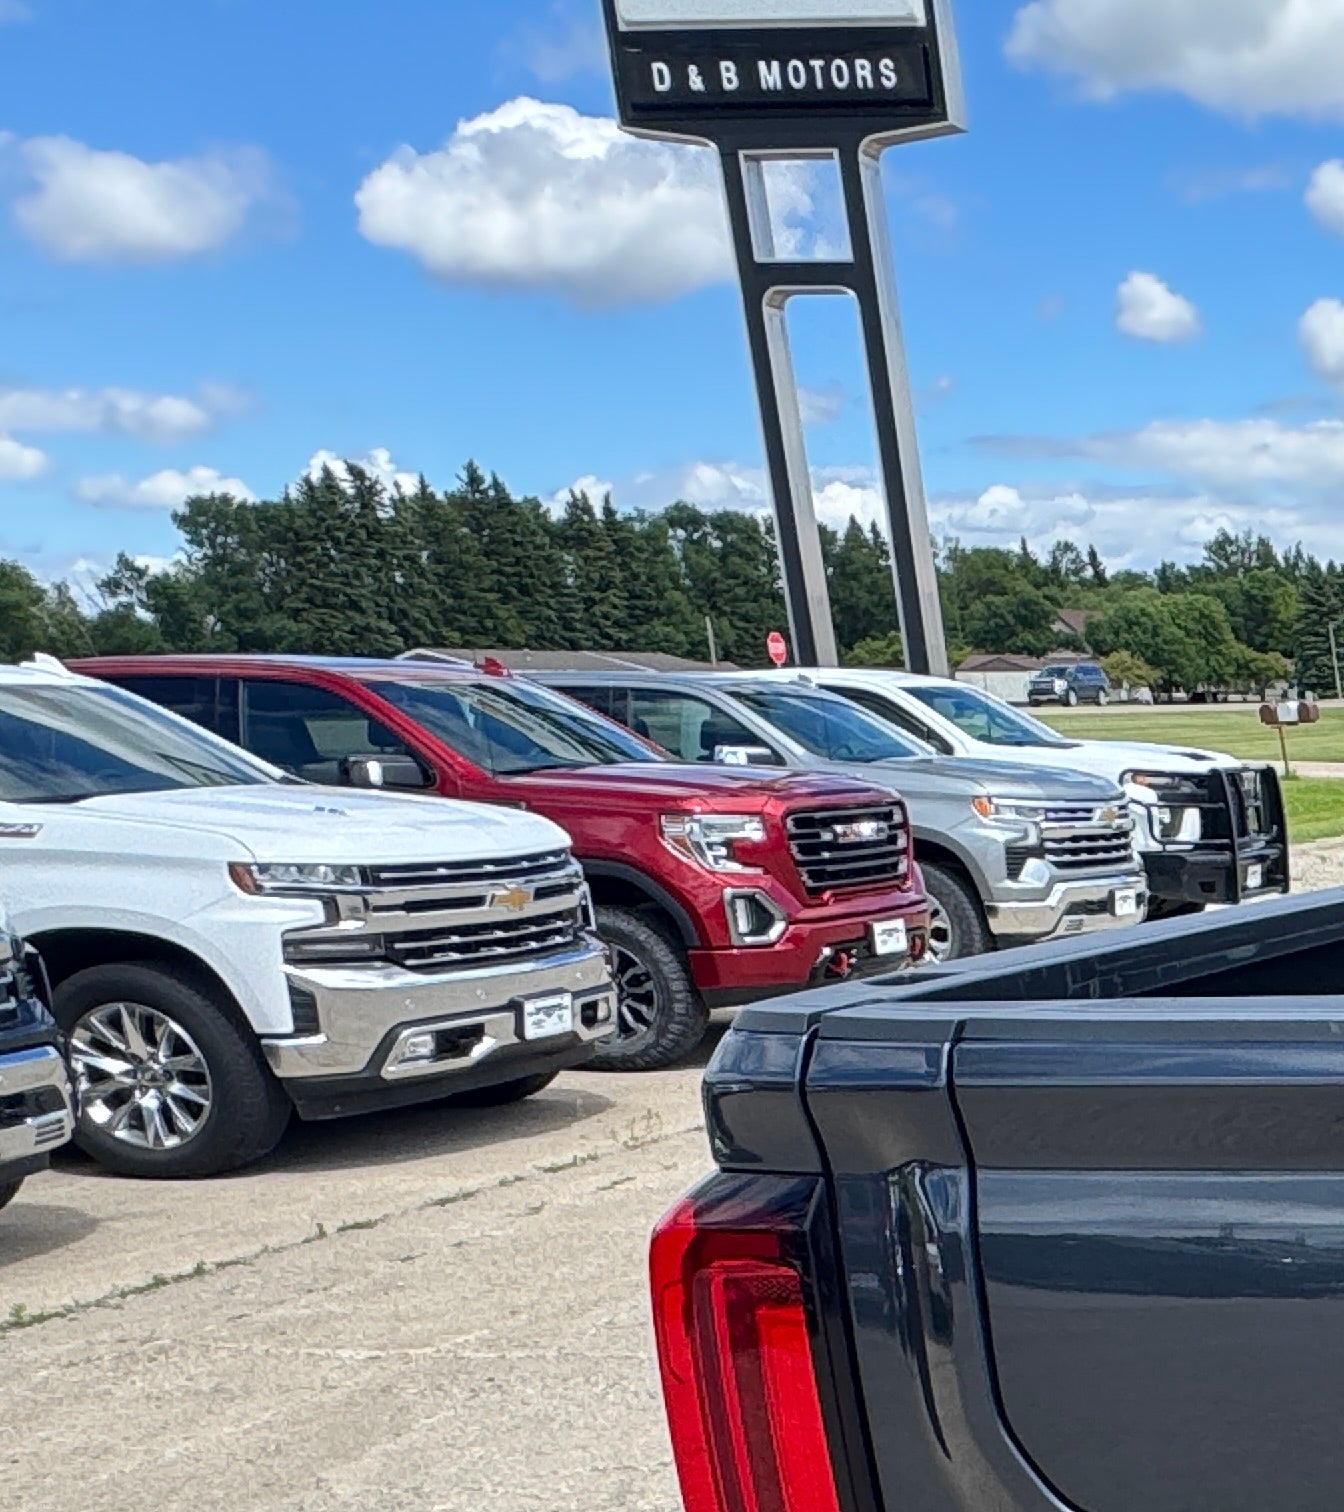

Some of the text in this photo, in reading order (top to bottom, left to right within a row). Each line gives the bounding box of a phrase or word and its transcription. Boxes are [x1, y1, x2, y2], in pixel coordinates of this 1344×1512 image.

[650, 57, 898, 92] D & B MOTORS
